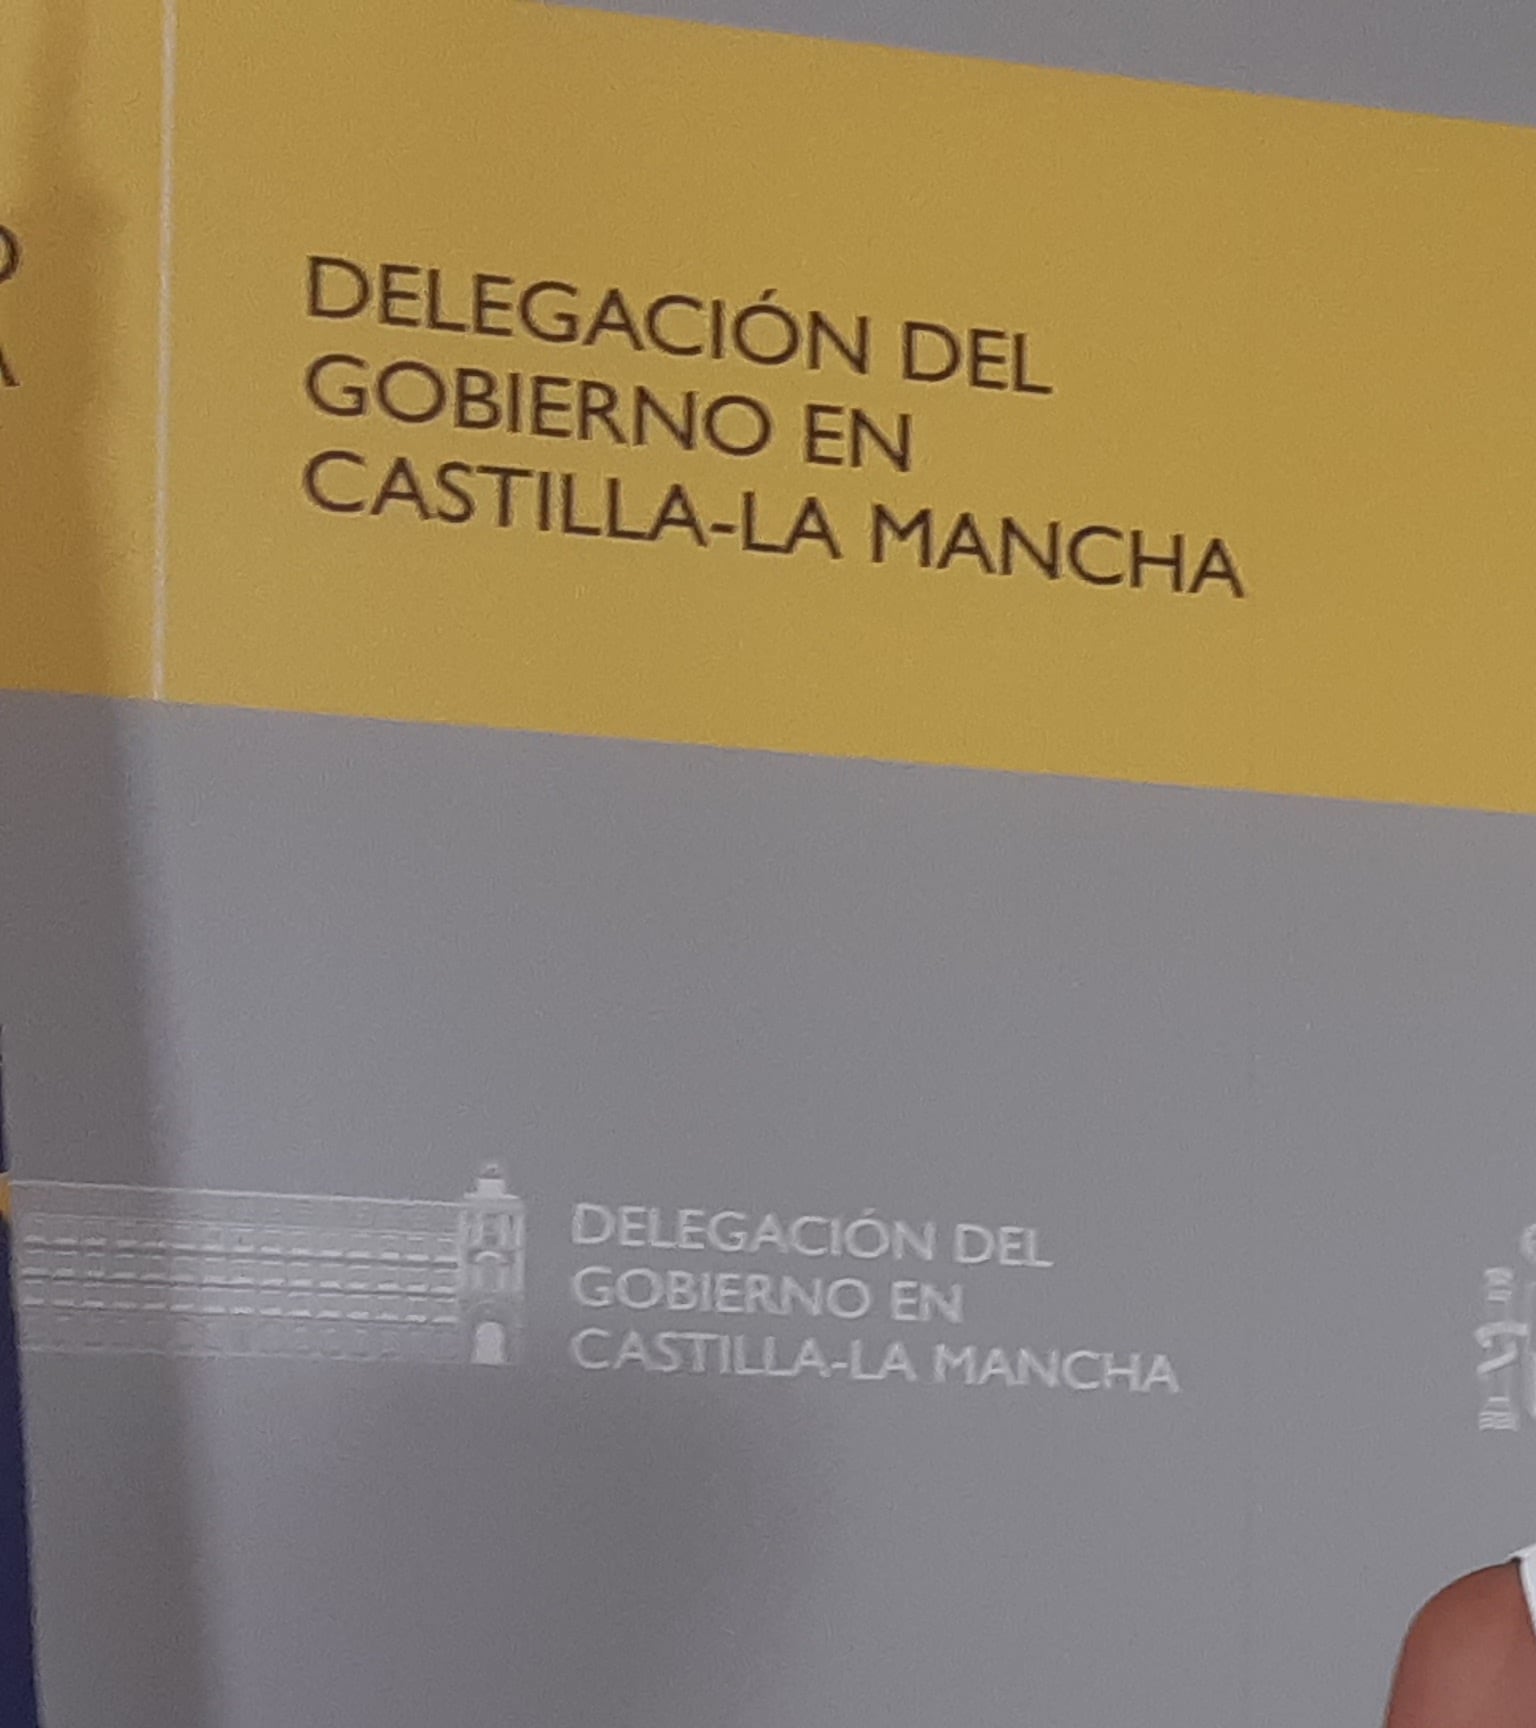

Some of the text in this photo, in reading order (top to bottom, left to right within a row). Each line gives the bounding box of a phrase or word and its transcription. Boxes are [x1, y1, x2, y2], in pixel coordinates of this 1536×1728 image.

[307, 254, 1053, 395] DELEGACIÓN DEL
[305, 353, 912, 473] GOBIERNO EN
[304, 449, 1245, 599] CASTILLA-LA MANCHA
[571, 1202, 1054, 1268] DELEGACIÓN DEL
[571, 1265, 964, 1324] GOBIERNO EN
[570, 1327, 1180, 1394] CASTILLA-LA MANCHA
